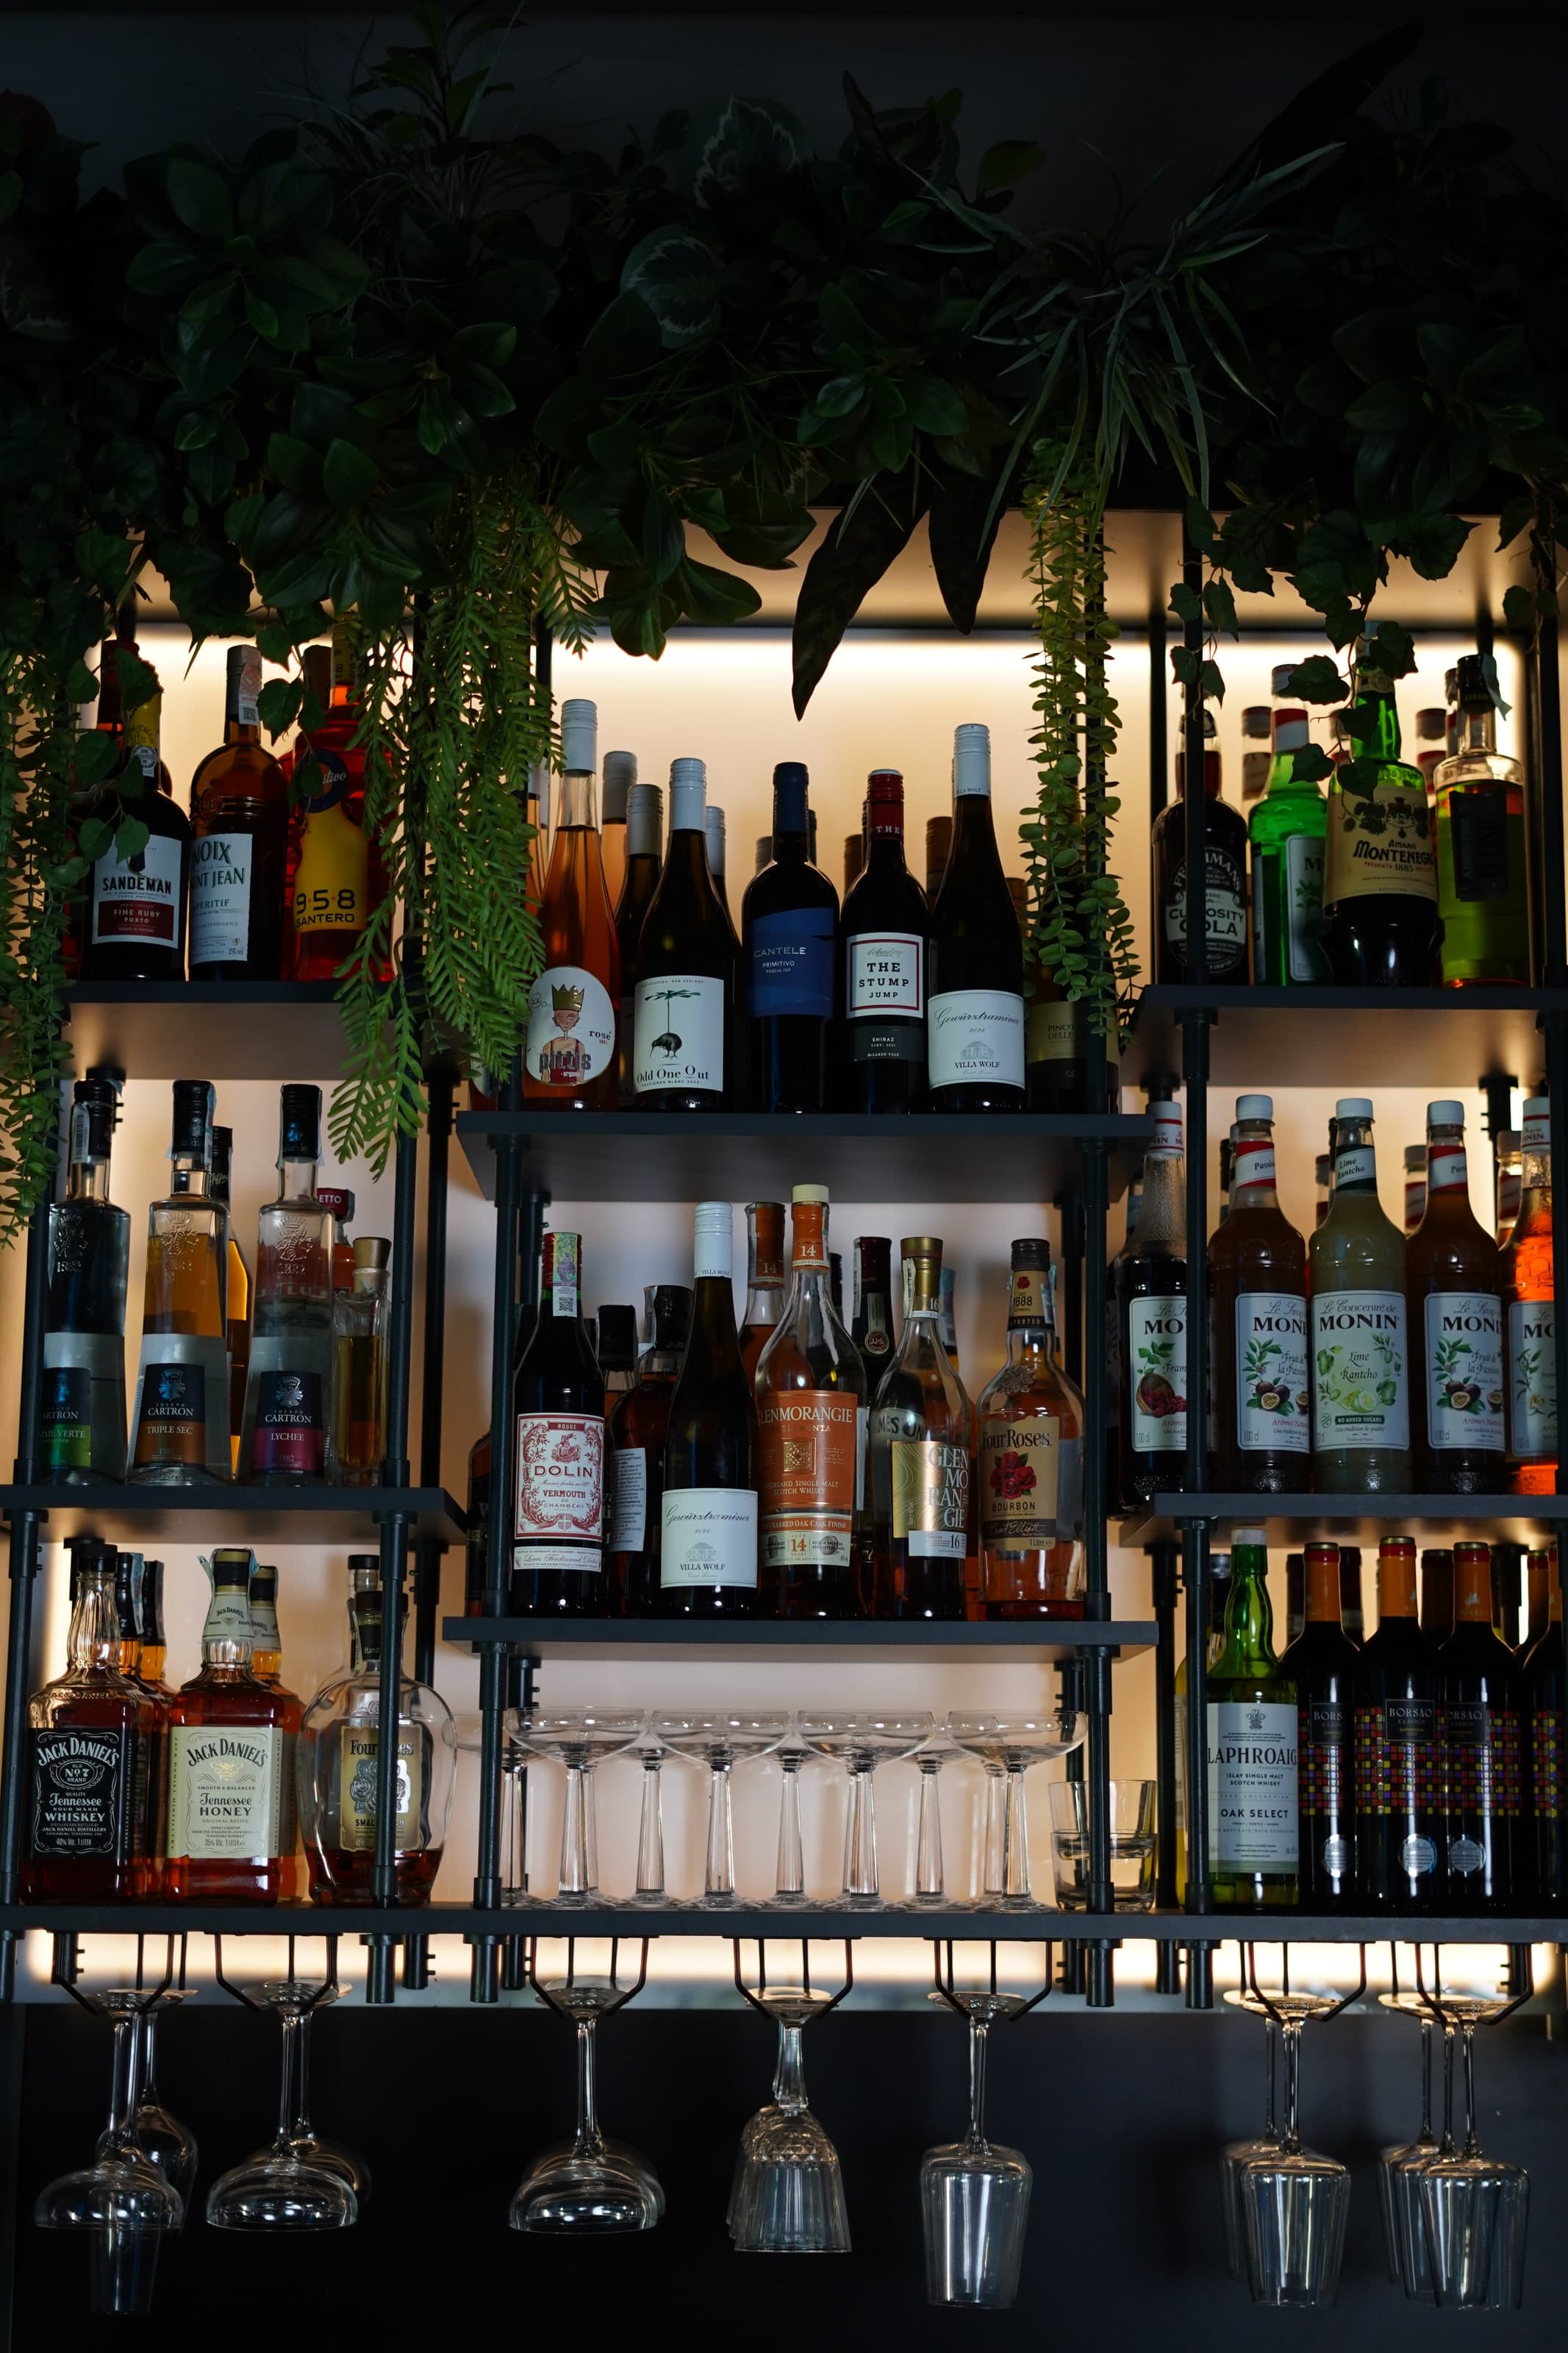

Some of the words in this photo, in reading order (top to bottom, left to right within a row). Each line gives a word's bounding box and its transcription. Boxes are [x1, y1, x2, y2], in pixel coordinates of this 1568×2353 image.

[876, 825, 901, 835] THE
[211, 867, 245, 889] JEAN
[102, 876, 171, 895] SANDEMAN
[137, 909, 161, 918] RUBY
[296, 913, 355, 928] SANTERO
[753, 946, 807, 959] CANTELE
[762, 960, 795, 968] PRIMITIVO
[867, 963, 901, 973] THE
[859, 978, 909, 988] STUMP
[978, 1060, 1000, 1068] WOLF
[656, 1068, 681, 1079] One
[684, 1065, 709, 1080] Out
[1339, 1158, 1358, 1170] Lime
[801, 1244, 817, 1257] 14
[763, 1261, 778, 1274] 14
[929, 1296, 939, 1313] 16
[1320, 1313, 1397, 1332] MONIN
[1347, 1351, 1370, 1368] Lime
[147, 1407, 195, 1417] CARTRON
[265, 1413, 312, 1424] CARTRON
[1337, 1418, 1346, 1426] NO
[1362, 1417, 1383, 1425] SUGARS
[57, 1429, 86, 1439] VERTE
[147, 1424, 176, 1435] TRIPLE
[176, 1425, 195, 1435] SEC
[1433, 1429, 1444, 1442] 100
[271, 1432, 306, 1442] LYCHEE
[982, 1429, 1007, 1451] Four
[1243, 1430, 1253, 1443] 100
[928, 1446, 970, 1470] GLEN
[534, 1465, 593, 1479] DOLIN
[794, 1479, 822, 1488] SINGLE
[823, 1480, 839, 1489] MALT
[945, 1470, 970, 1490] MO
[543, 1489, 587, 1499] VERMOUTH
[773, 1488, 798, 1496] SCOTCH
[799, 1486, 825, 1496] WHISKY
[928, 1488, 963, 1508] RAN
[992, 1502, 1036, 1513] BOURBON
[794, 1519, 809, 1527] OAK
[809, 1518, 827, 1527] CASK
[827, 1521, 847, 1529] FINISH
[943, 1507, 965, 1529] GIE
[790, 1537, 808, 1552] 14
[950, 1534, 960, 1549] 16
[1389, 1706, 1433, 1719] BORSAO
[37, 1740, 71, 1768] JACK
[70, 1737, 121, 1768] DANIEL'S
[187, 1741, 220, 1768] JACK
[219, 1738, 268, 1768] DANIEL'S
[350, 1739, 378, 1756] Four
[49, 1792, 103, 1807] Tennessee
[199, 1792, 253, 1806] Tennessee
[44, 1812, 106, 1822] WHISKEY
[199, 1807, 252, 1816] HONEY
[1220, 1808, 1245, 1818] OAK
[1250, 1808, 1289, 1819] SELECT
[356, 1818, 376, 1827] SMAL
